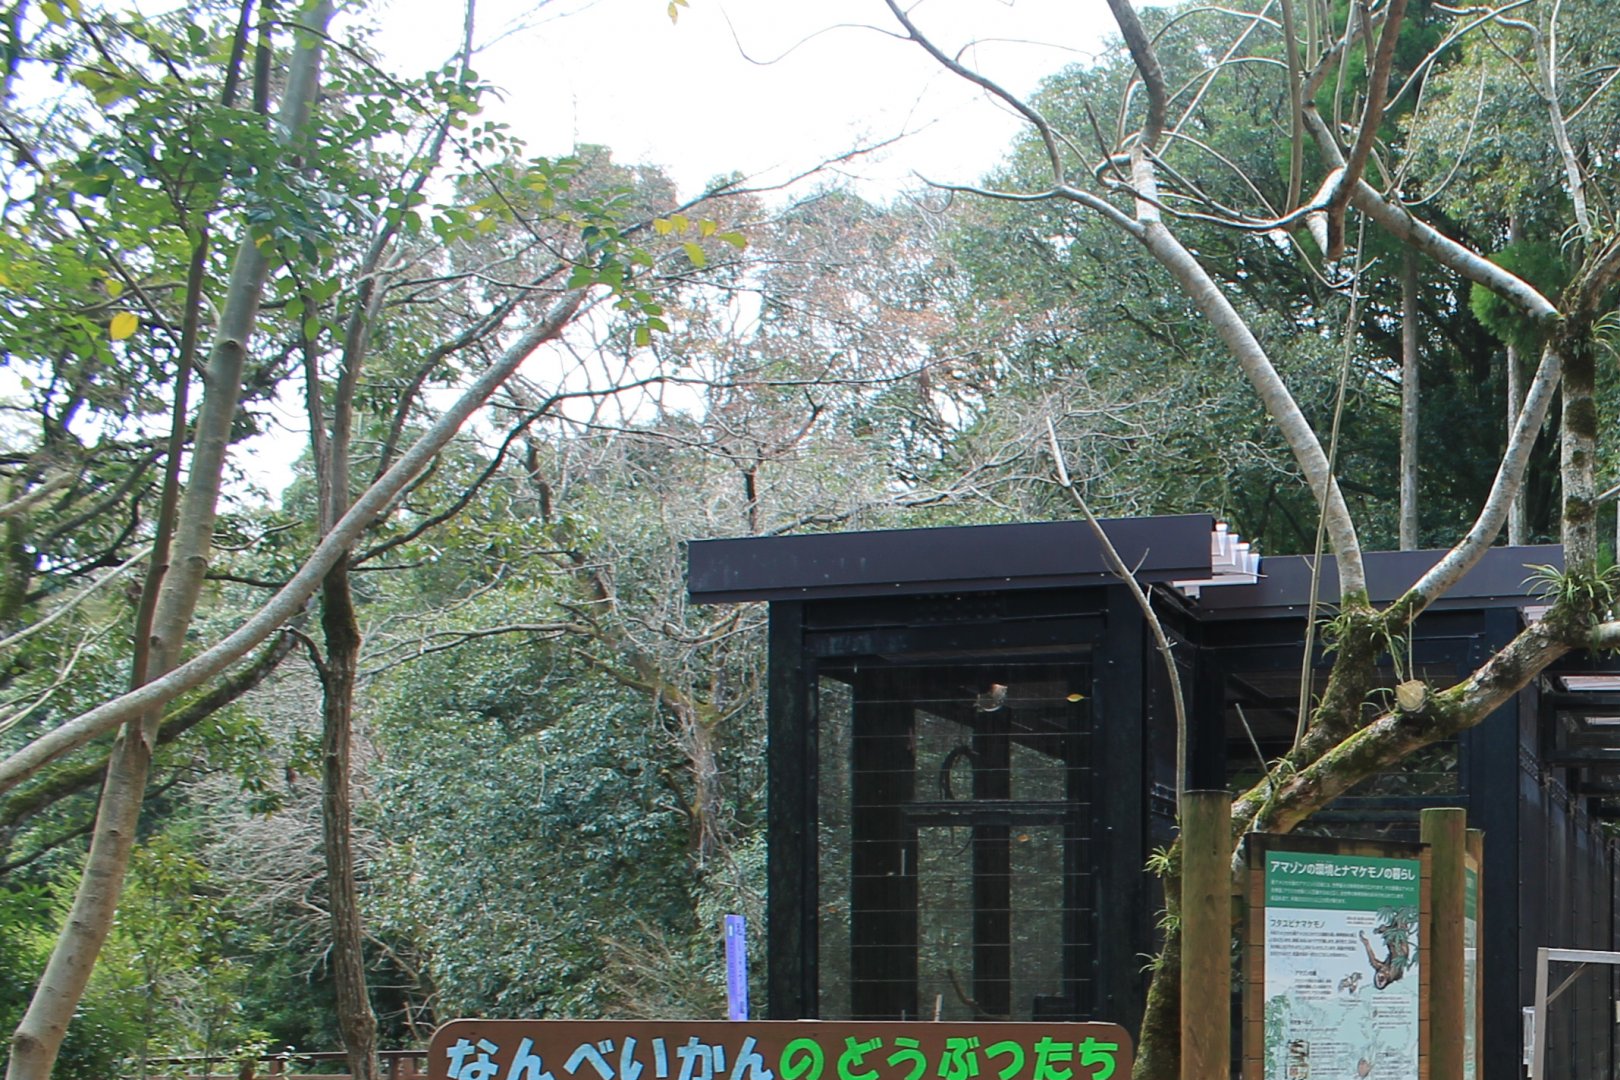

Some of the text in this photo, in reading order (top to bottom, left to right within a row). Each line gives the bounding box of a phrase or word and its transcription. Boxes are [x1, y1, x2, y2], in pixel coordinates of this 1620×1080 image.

[1270, 860, 1416, 881] アマゾンの環境とナマケモノの暮らし
